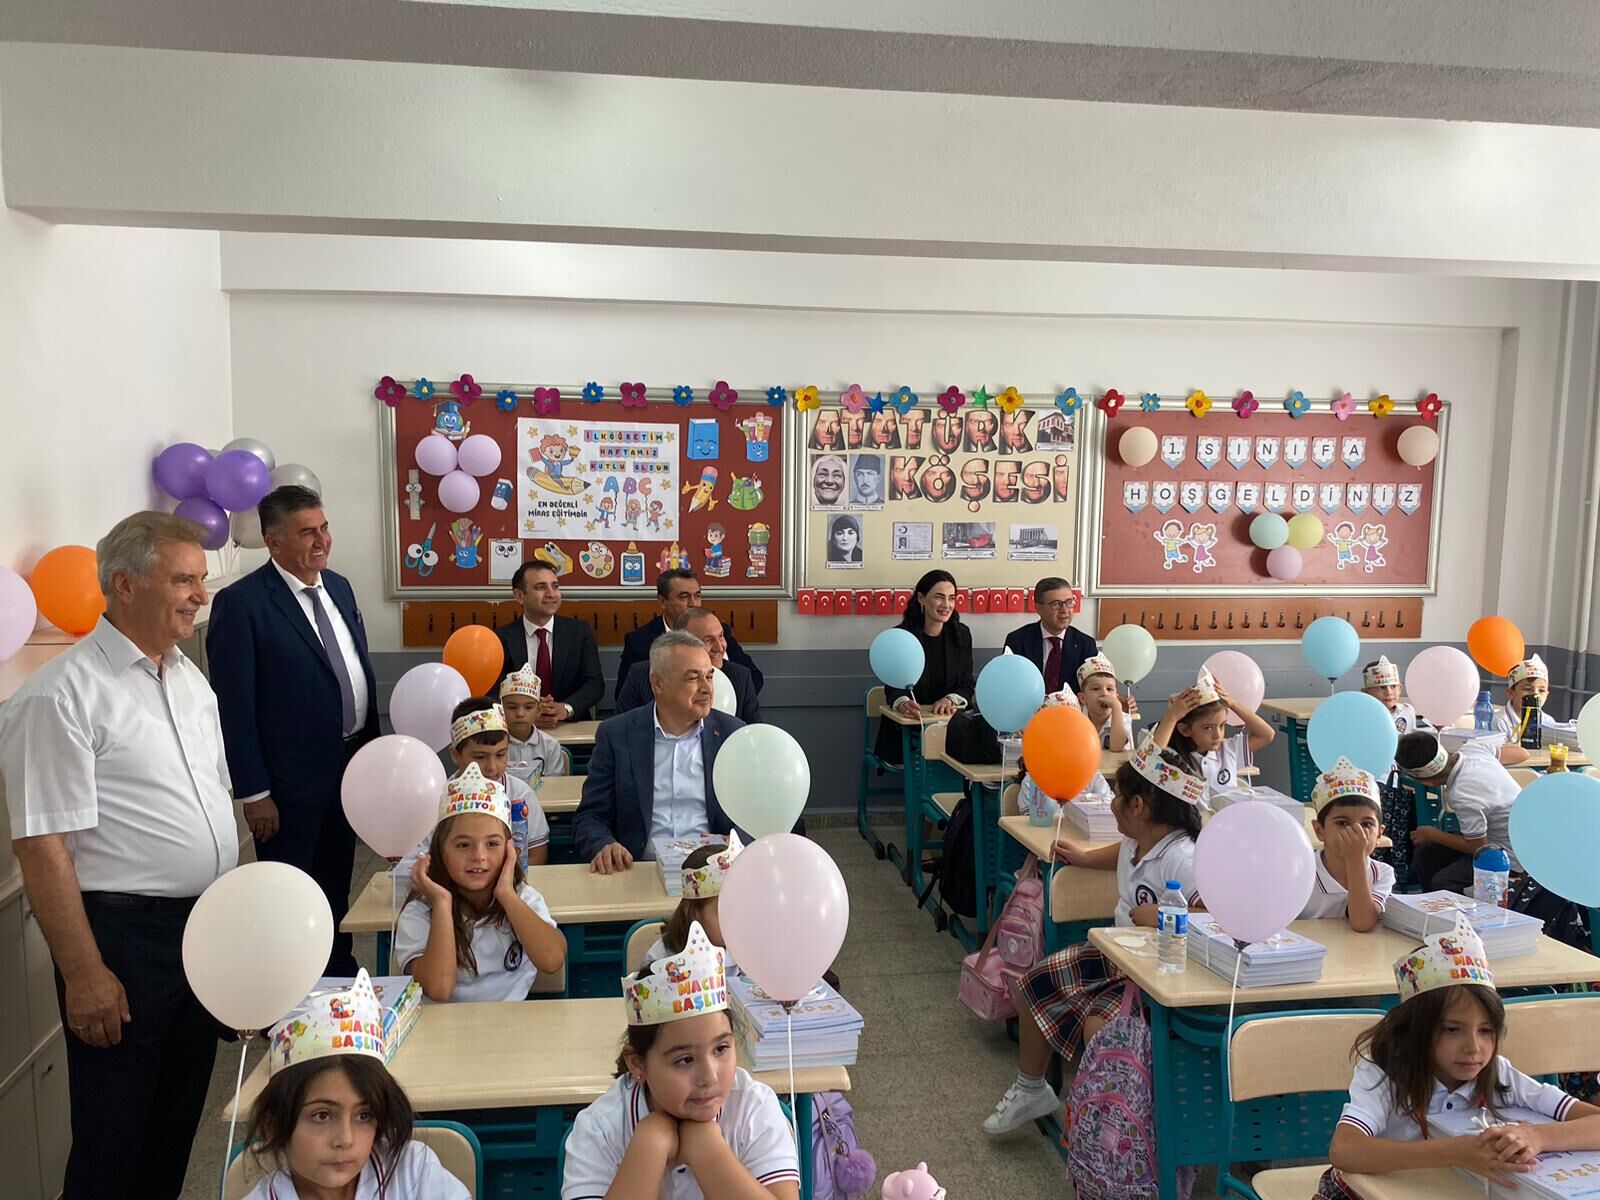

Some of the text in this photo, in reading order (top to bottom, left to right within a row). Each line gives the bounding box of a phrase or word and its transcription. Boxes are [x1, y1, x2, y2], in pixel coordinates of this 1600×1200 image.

[808, 407, 1035, 455] ATATÜRK
[1168, 441, 1360, 456] 1. SINIFA
[889, 454, 1070, 512] KÖŞESİ
[1129, 486, 1414, 504] HOŞGELDİNİZ
